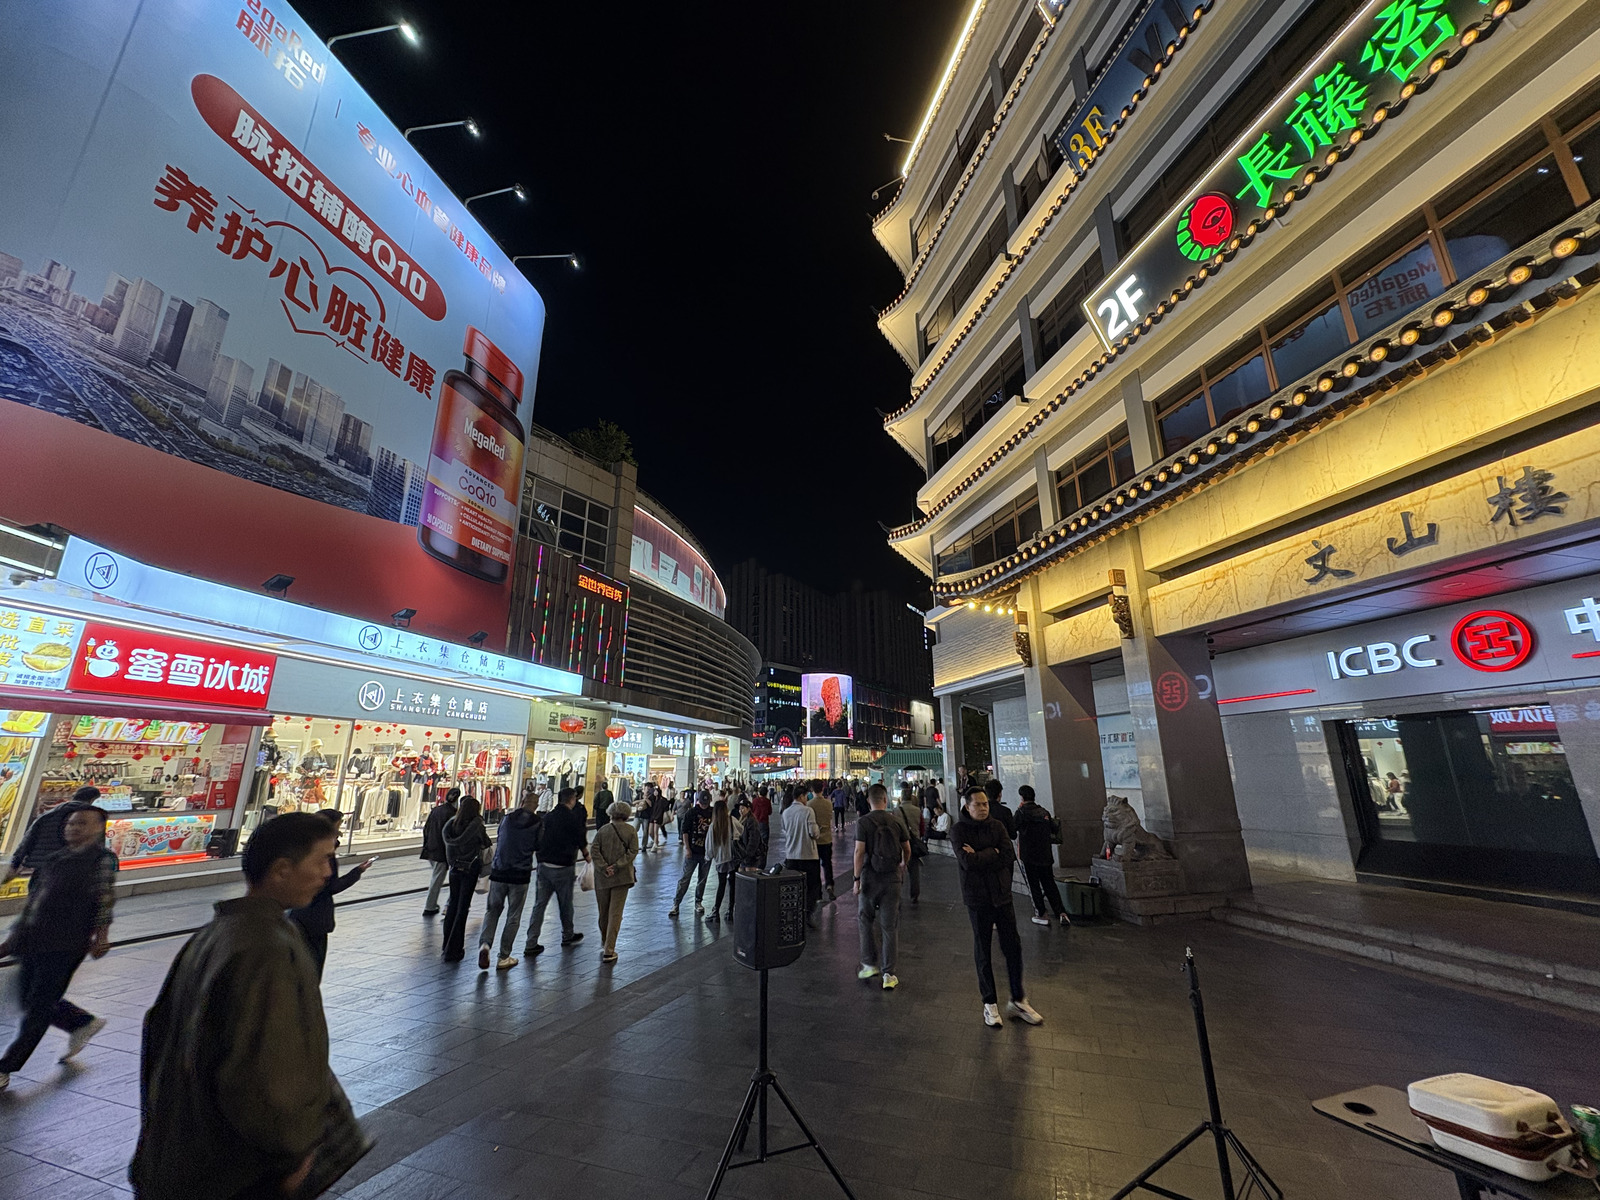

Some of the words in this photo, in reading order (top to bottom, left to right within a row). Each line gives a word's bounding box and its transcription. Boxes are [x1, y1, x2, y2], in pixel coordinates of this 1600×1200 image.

[235, 9, 304, 91] 脉拓
[244, 0, 327, 87] egaRed
[1236, 0, 1500, 208] 長藤密
[1069, 106, 1106, 168] 3F
[356, 121, 507, 296] 专业心血管健康品牌
[154, 164, 436, 401] 养护心脏健康
[1097, 275, 1149, 341] 2F
[463, 416, 506, 461] MegaRed
[458, 475, 497, 508] CoQ10
[464, 468, 495, 491] ADVANCED
[125, 647, 270, 697] 蜜雪冰城
[1327, 634, 1437, 680] ICBC
[548, 711, 598, 730] 金百货
